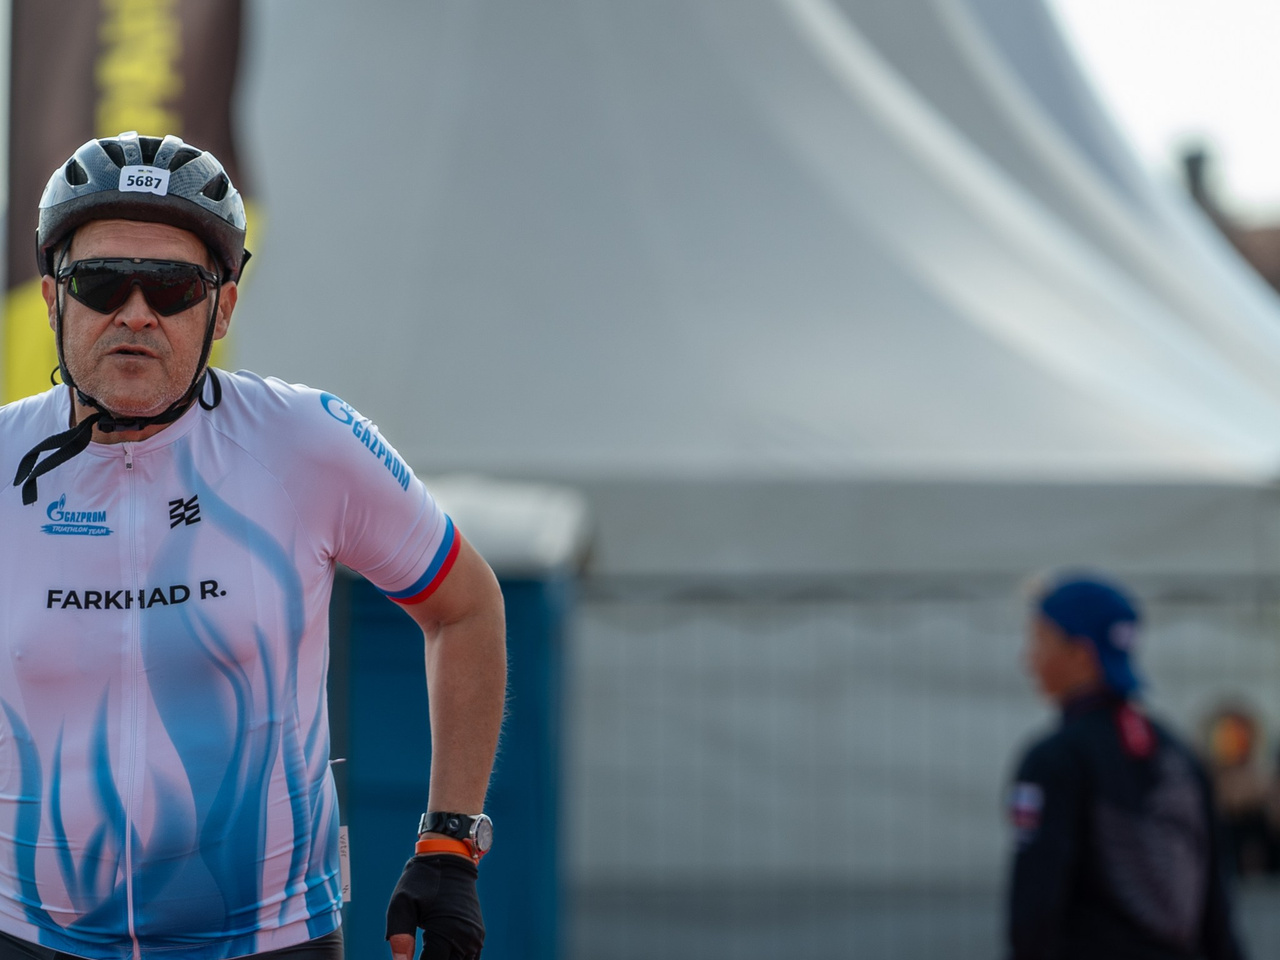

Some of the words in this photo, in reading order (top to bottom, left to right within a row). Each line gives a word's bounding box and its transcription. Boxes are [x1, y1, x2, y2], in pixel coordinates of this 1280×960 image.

[126, 175, 162, 189] 5687
[352, 420, 411, 492] GAZPROM
[64, 510, 106, 523] GAZPROM
[52, 525, 88, 533] TRIATHLON
[46, 584, 191, 610] FARKHAD
[199, 579, 227, 600] R.
